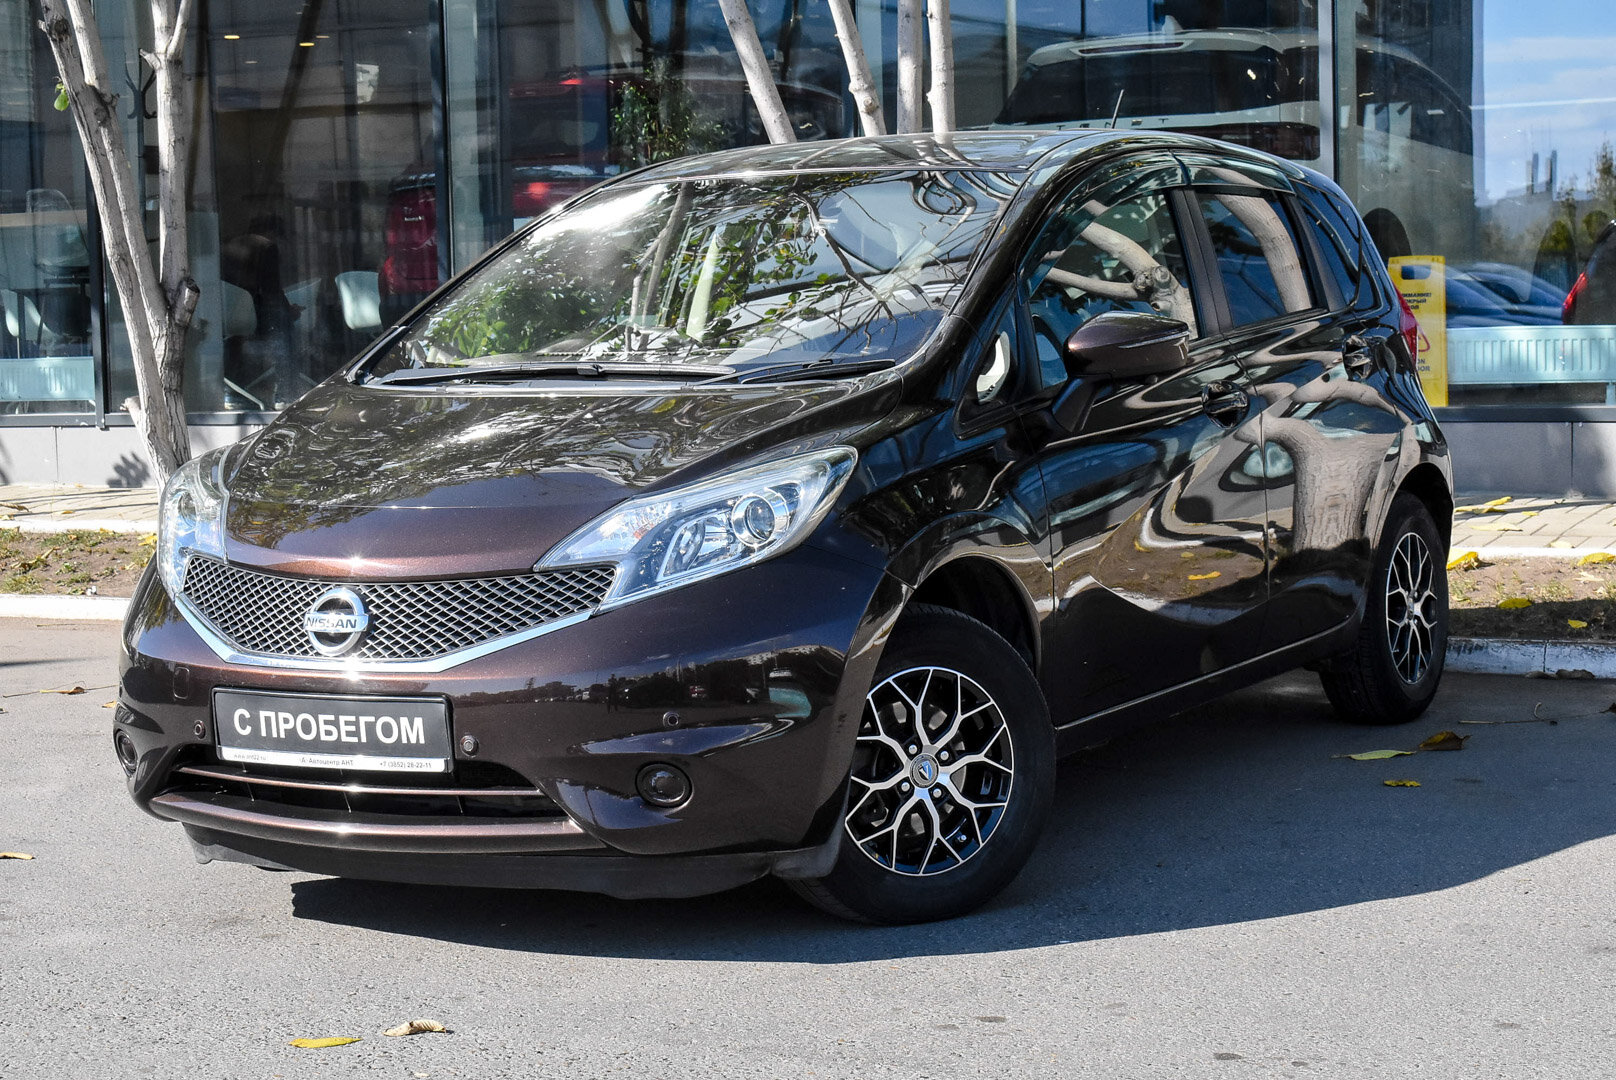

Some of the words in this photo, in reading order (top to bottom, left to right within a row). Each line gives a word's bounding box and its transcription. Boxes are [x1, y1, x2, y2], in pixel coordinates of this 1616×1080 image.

[306, 617, 357, 629] NISSAN
[233, 708, 251, 736] С
[259, 710, 426, 744] ПРОБЕГОМ
